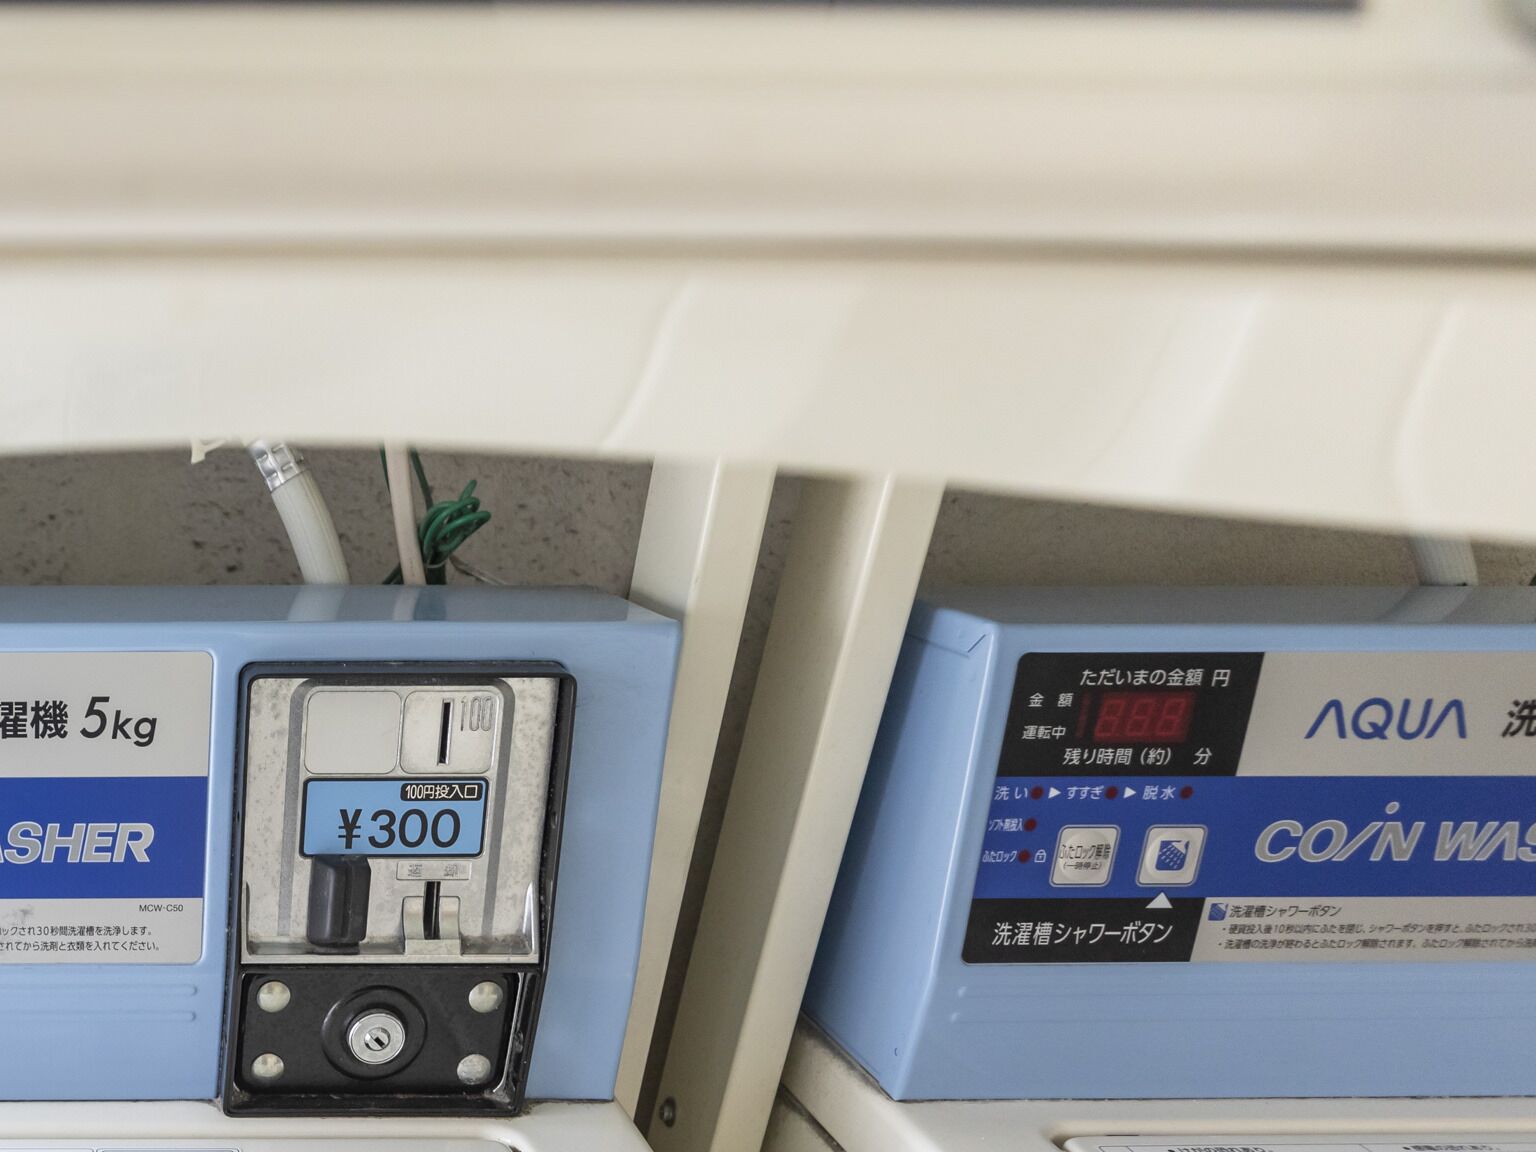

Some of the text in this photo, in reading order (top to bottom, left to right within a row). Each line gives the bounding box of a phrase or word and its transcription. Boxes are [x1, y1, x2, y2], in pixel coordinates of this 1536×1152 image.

[1080, 668, 1231, 687] ただいまの金額 円
[79, 695, 157, 748] 5kg
[1304, 697, 1468, 741] AQUA
[1022, 725, 1066, 740] 運転中
[1193, 748, 1212, 766] 分
[405, 784, 478, 800] 100円投入口
[1066, 785, 1104, 800] すすぎ
[337, 807, 461, 850] ¥300
[1254, 801, 1426, 863] COIN
[982, 850, 1017, 863] ふたロック
[1230, 904, 1342, 919] 洗濯槽シャワーボタン
[991, 920, 1173, 947] 洗濯槽シャワーボタン
